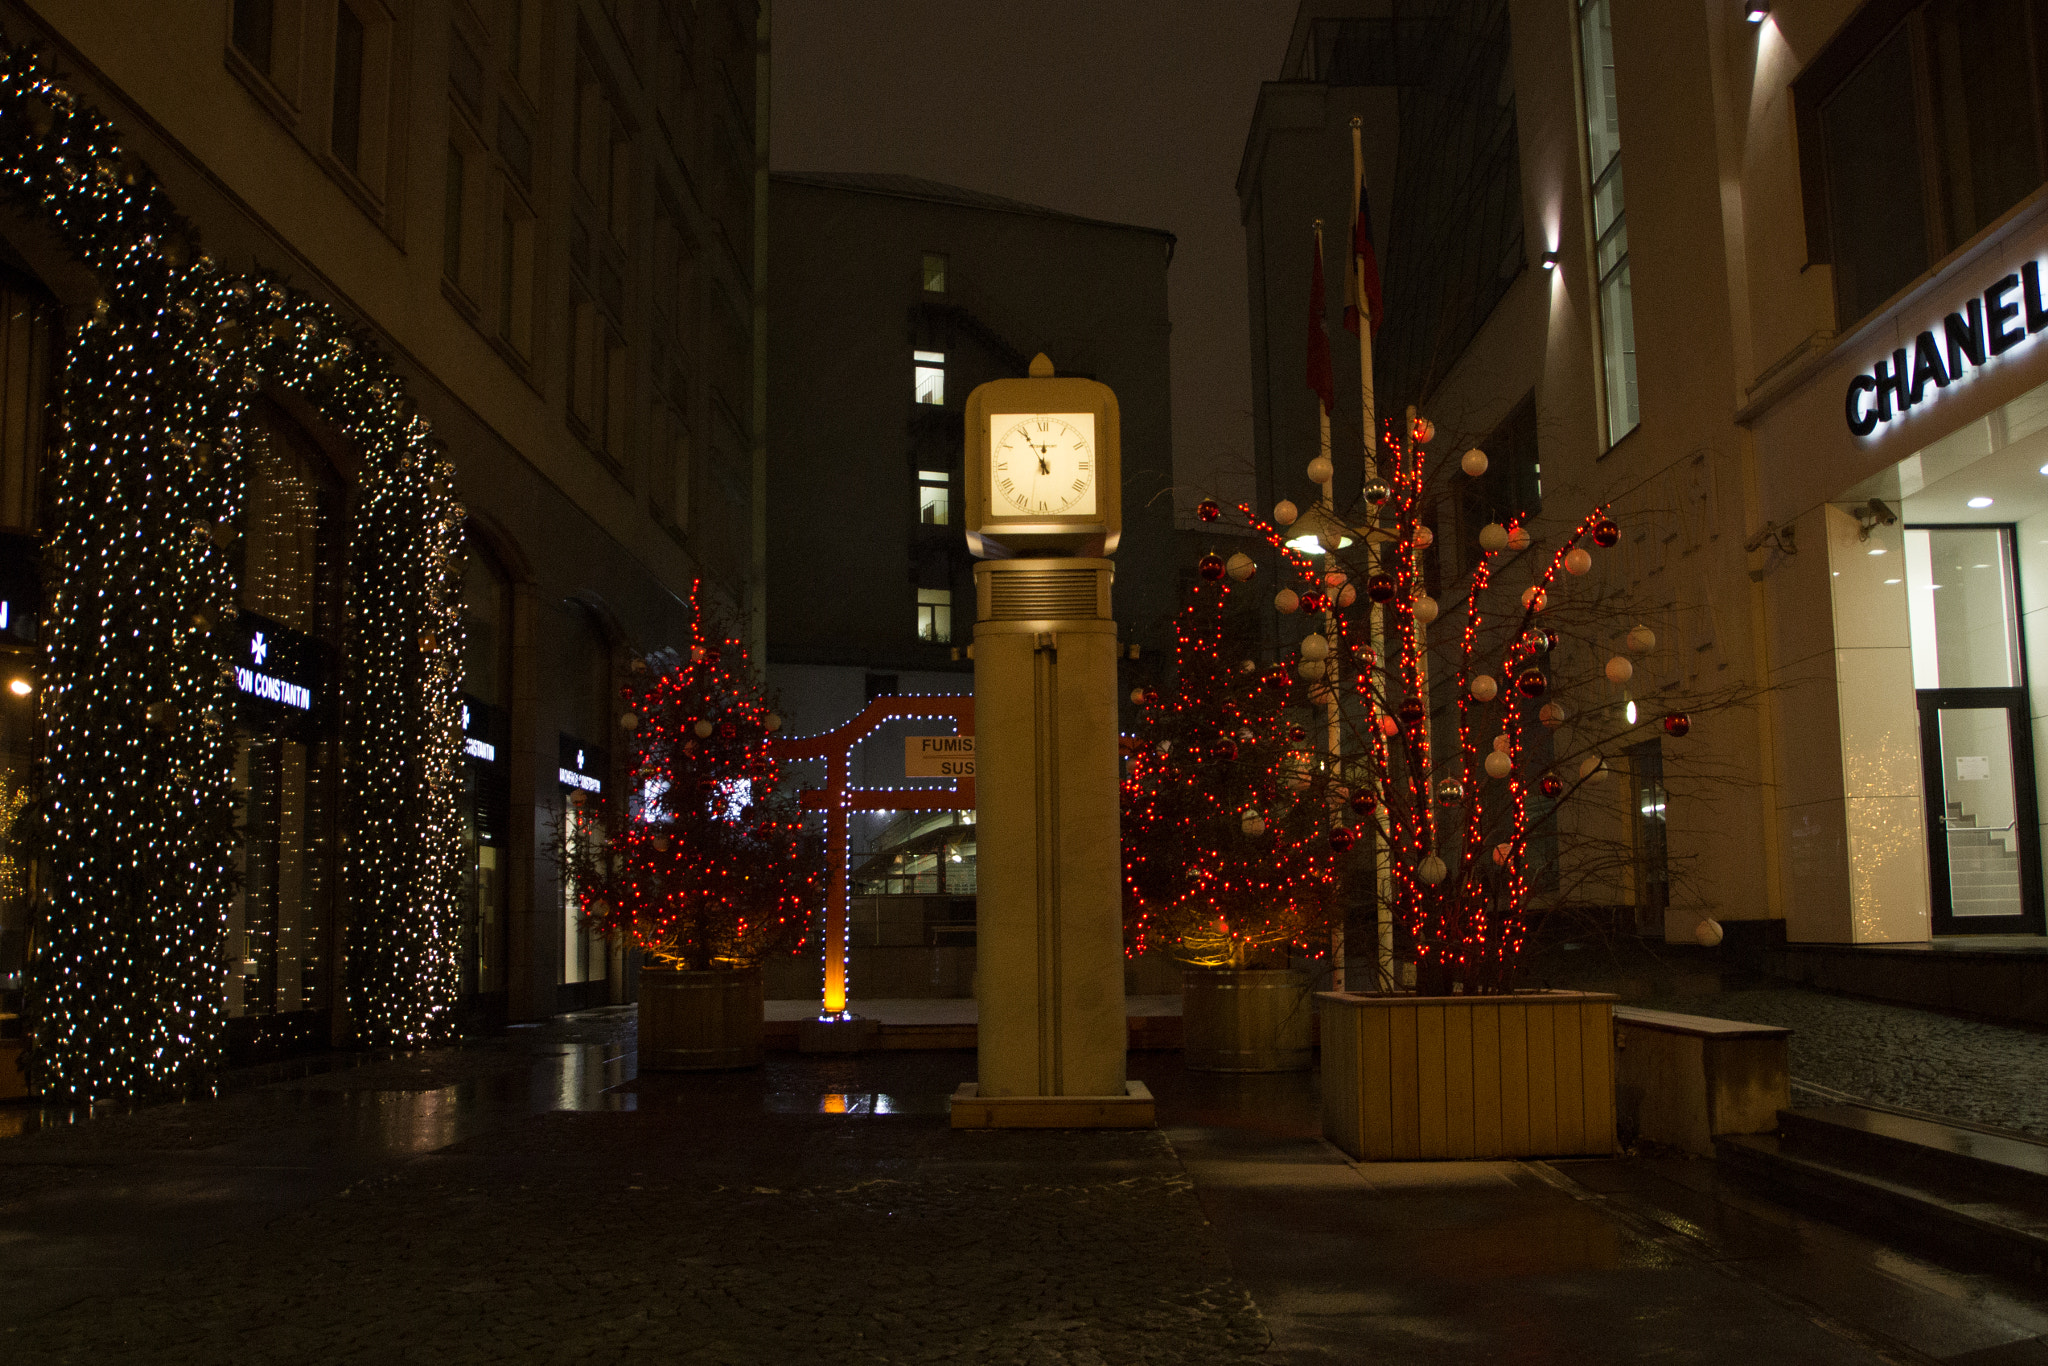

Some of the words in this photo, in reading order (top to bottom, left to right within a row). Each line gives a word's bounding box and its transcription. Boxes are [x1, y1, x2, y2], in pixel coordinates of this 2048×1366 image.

[1846, 261, 2048, 436] CHANEL
[235, 665, 253, 693] ON
[254, 672, 310, 710] CONSTANTIN
[922, 738, 976, 752] FUMIS
